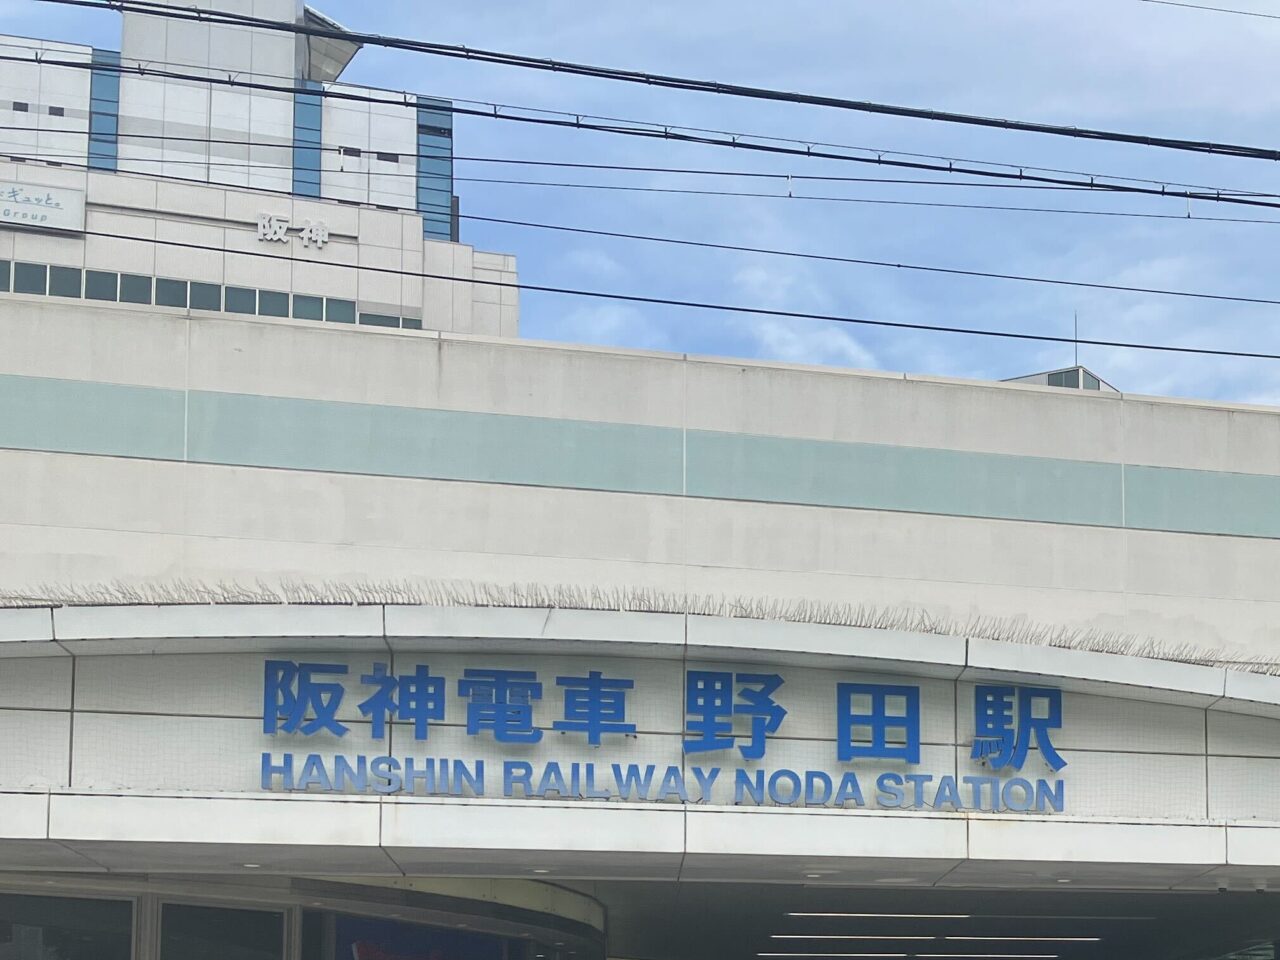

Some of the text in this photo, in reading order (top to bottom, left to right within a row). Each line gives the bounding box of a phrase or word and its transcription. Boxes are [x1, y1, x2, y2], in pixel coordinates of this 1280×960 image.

[3, 208, 48, 221] Group
[256, 213, 329, 250] 阪神
[263, 660, 1068, 773] 阪神電車 野田駅
[261, 752, 1064, 812] HANSHIN RAILWAY NODA STATION
